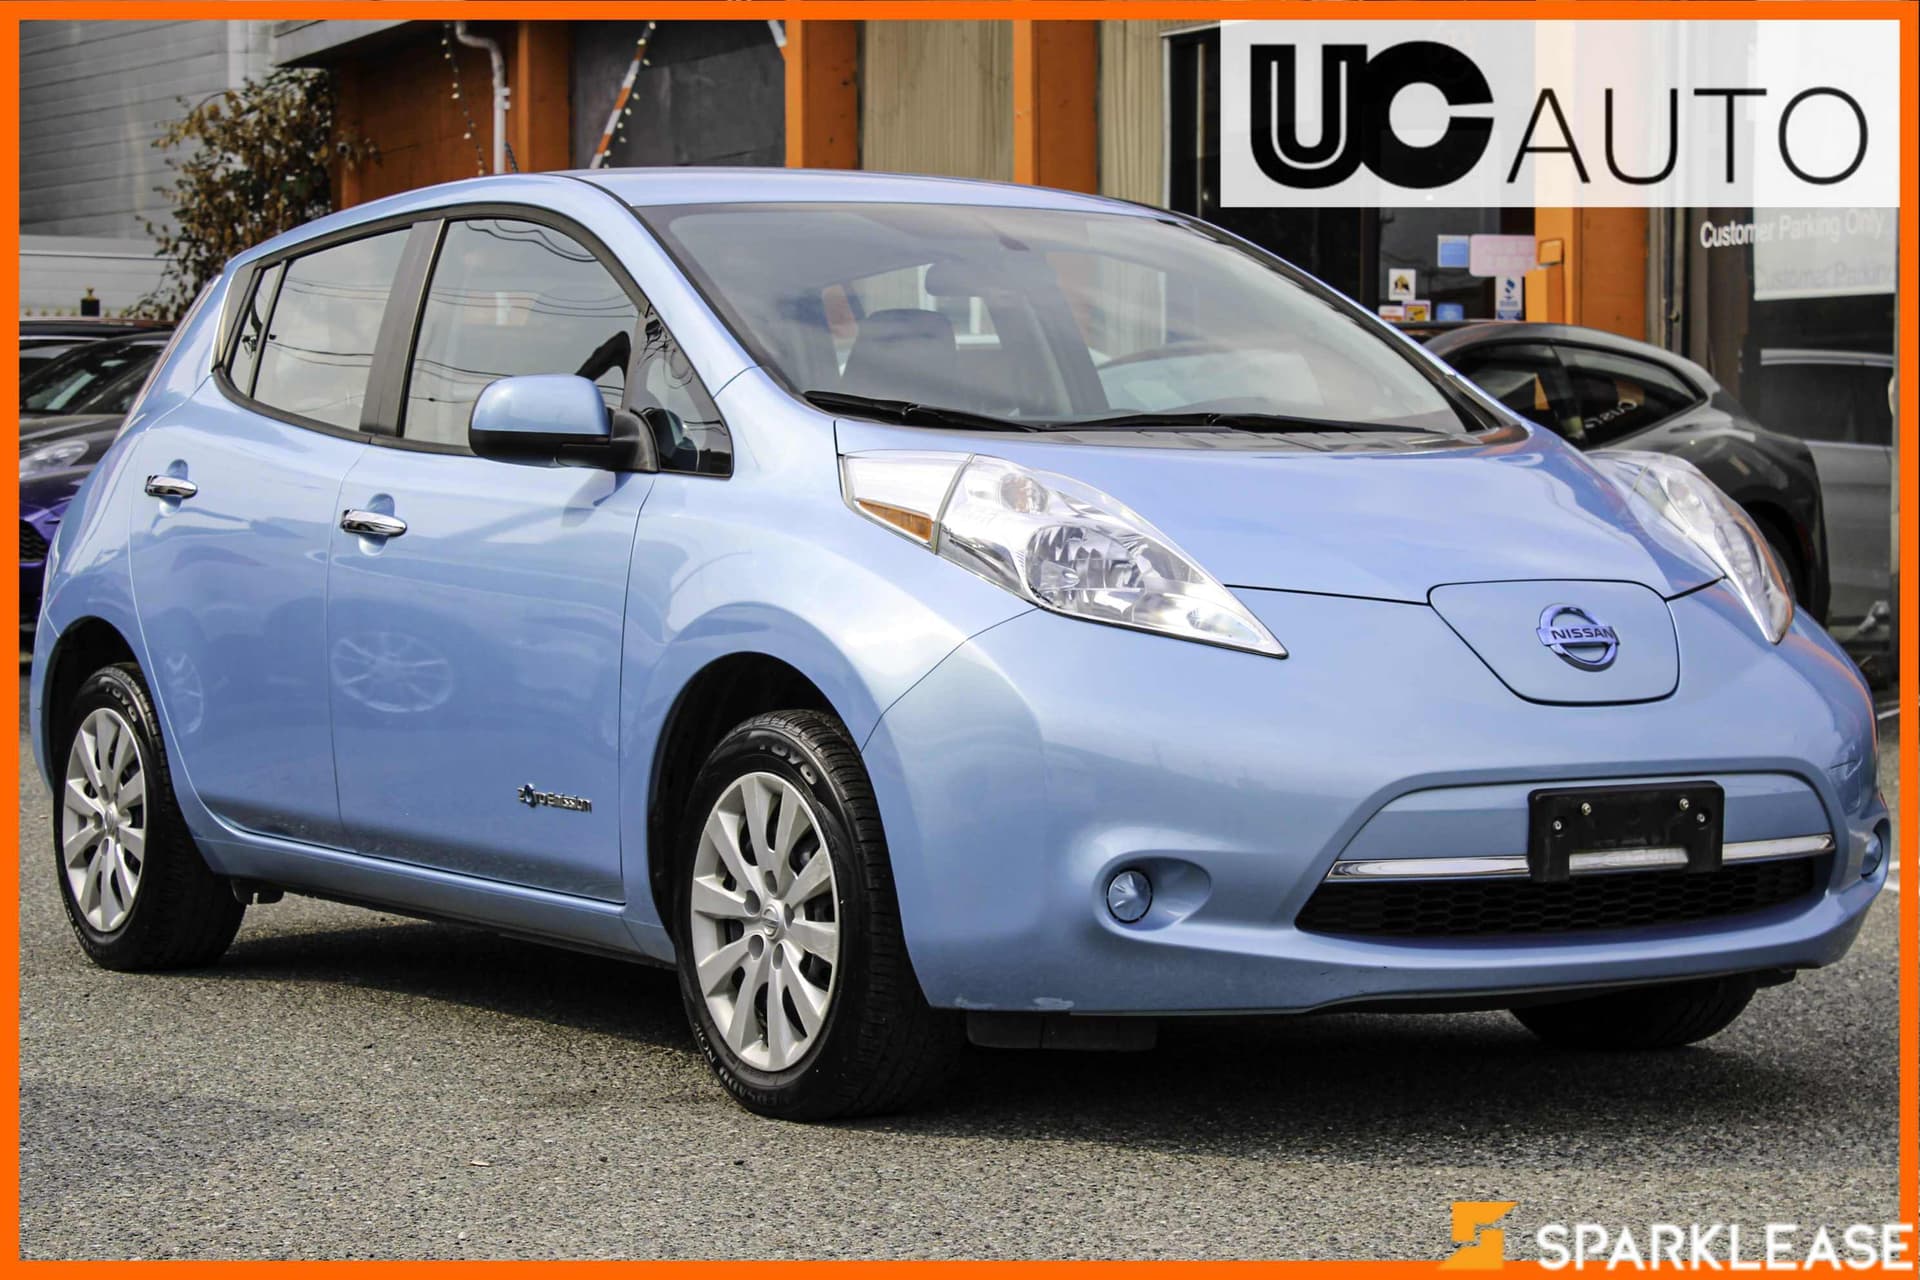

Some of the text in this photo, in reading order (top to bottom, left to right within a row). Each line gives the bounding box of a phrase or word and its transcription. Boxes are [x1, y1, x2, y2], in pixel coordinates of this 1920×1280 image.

[1700, 207, 1886, 248] Customer Parking Only
[1551, 627, 1615, 640] NISSAN
[752, 737, 818, 785] TOYO
